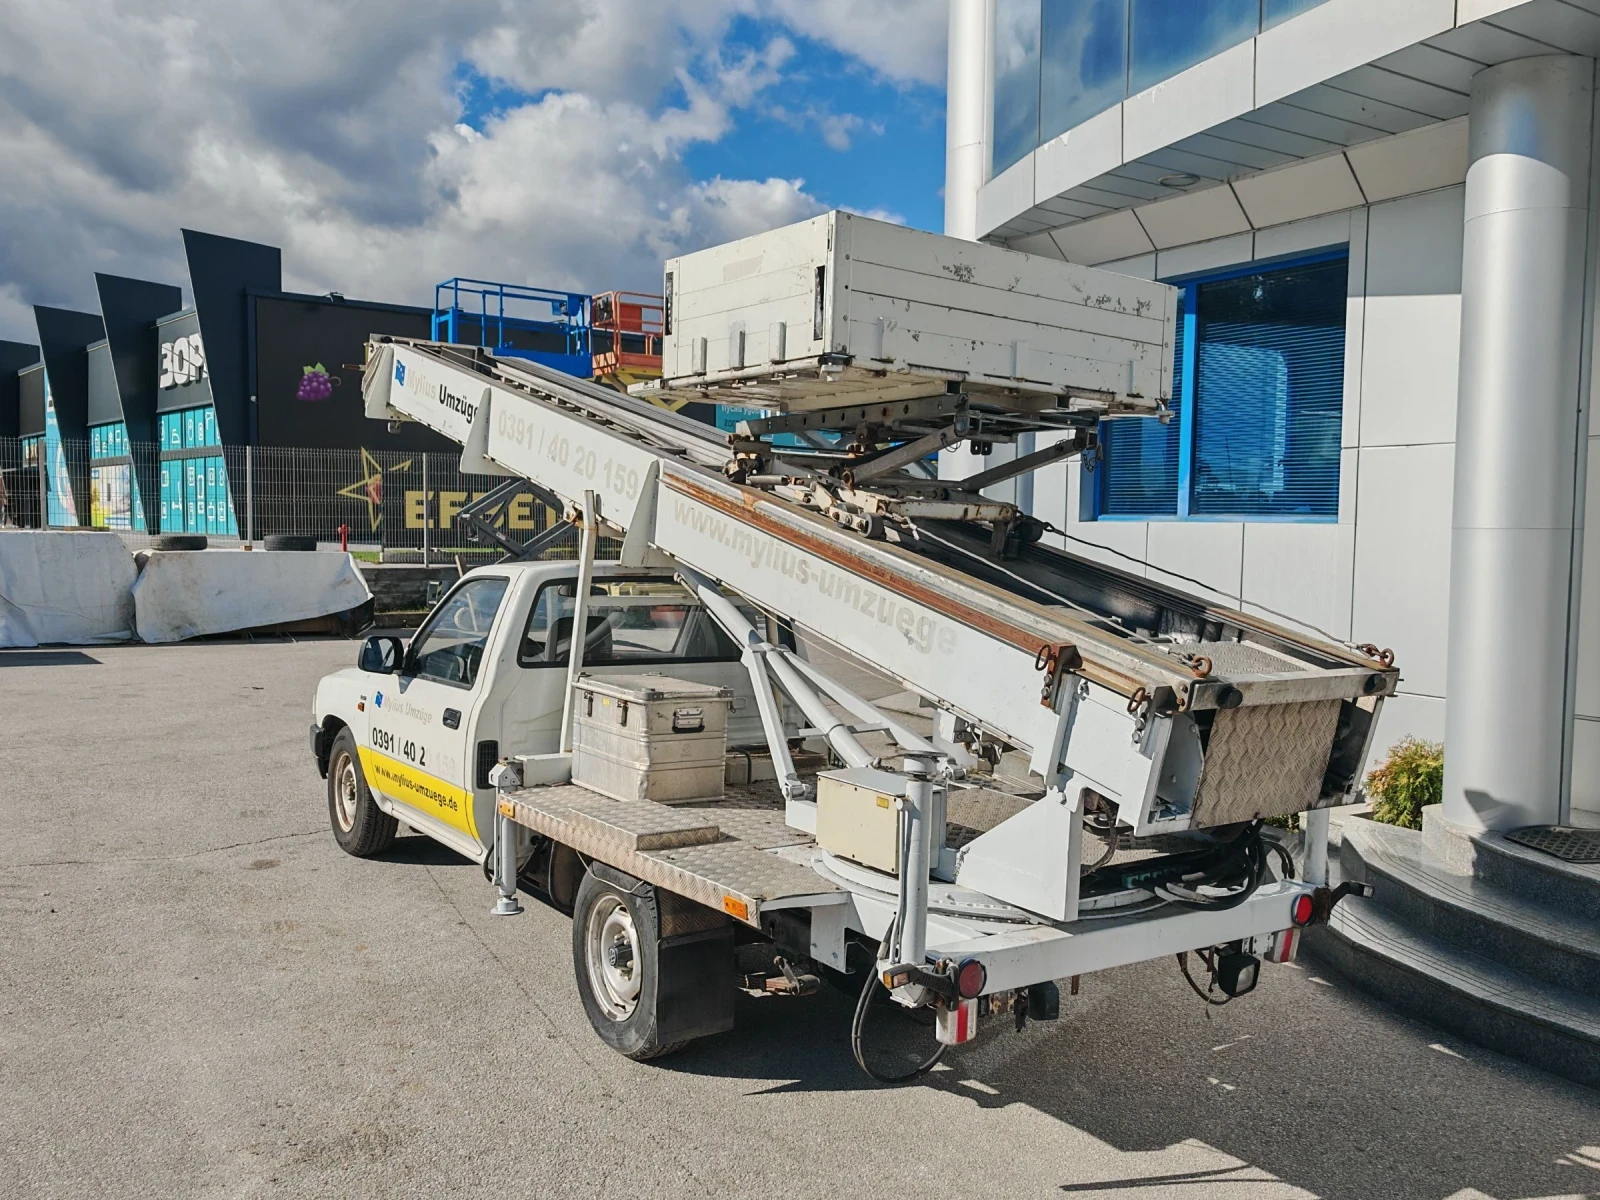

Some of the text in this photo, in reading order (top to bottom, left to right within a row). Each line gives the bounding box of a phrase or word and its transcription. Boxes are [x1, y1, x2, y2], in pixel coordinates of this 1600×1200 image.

[160, 333, 209, 388] ЗОР
[406, 367, 437, 400] Mylius
[498, 409, 534, 450] 0391
[548, 433, 570, 468] 40
[573, 445, 597, 480] 20
[603, 457, 639, 501] 159
[673, 499, 958, 654] www.mylius-umzuege
[384, 695, 433, 726] Mylius Umzüge
[372, 727, 395, 754] 0391
[403, 739, 416, 763] 40
[374, 764, 459, 812] www.mylius-umzuege.de
